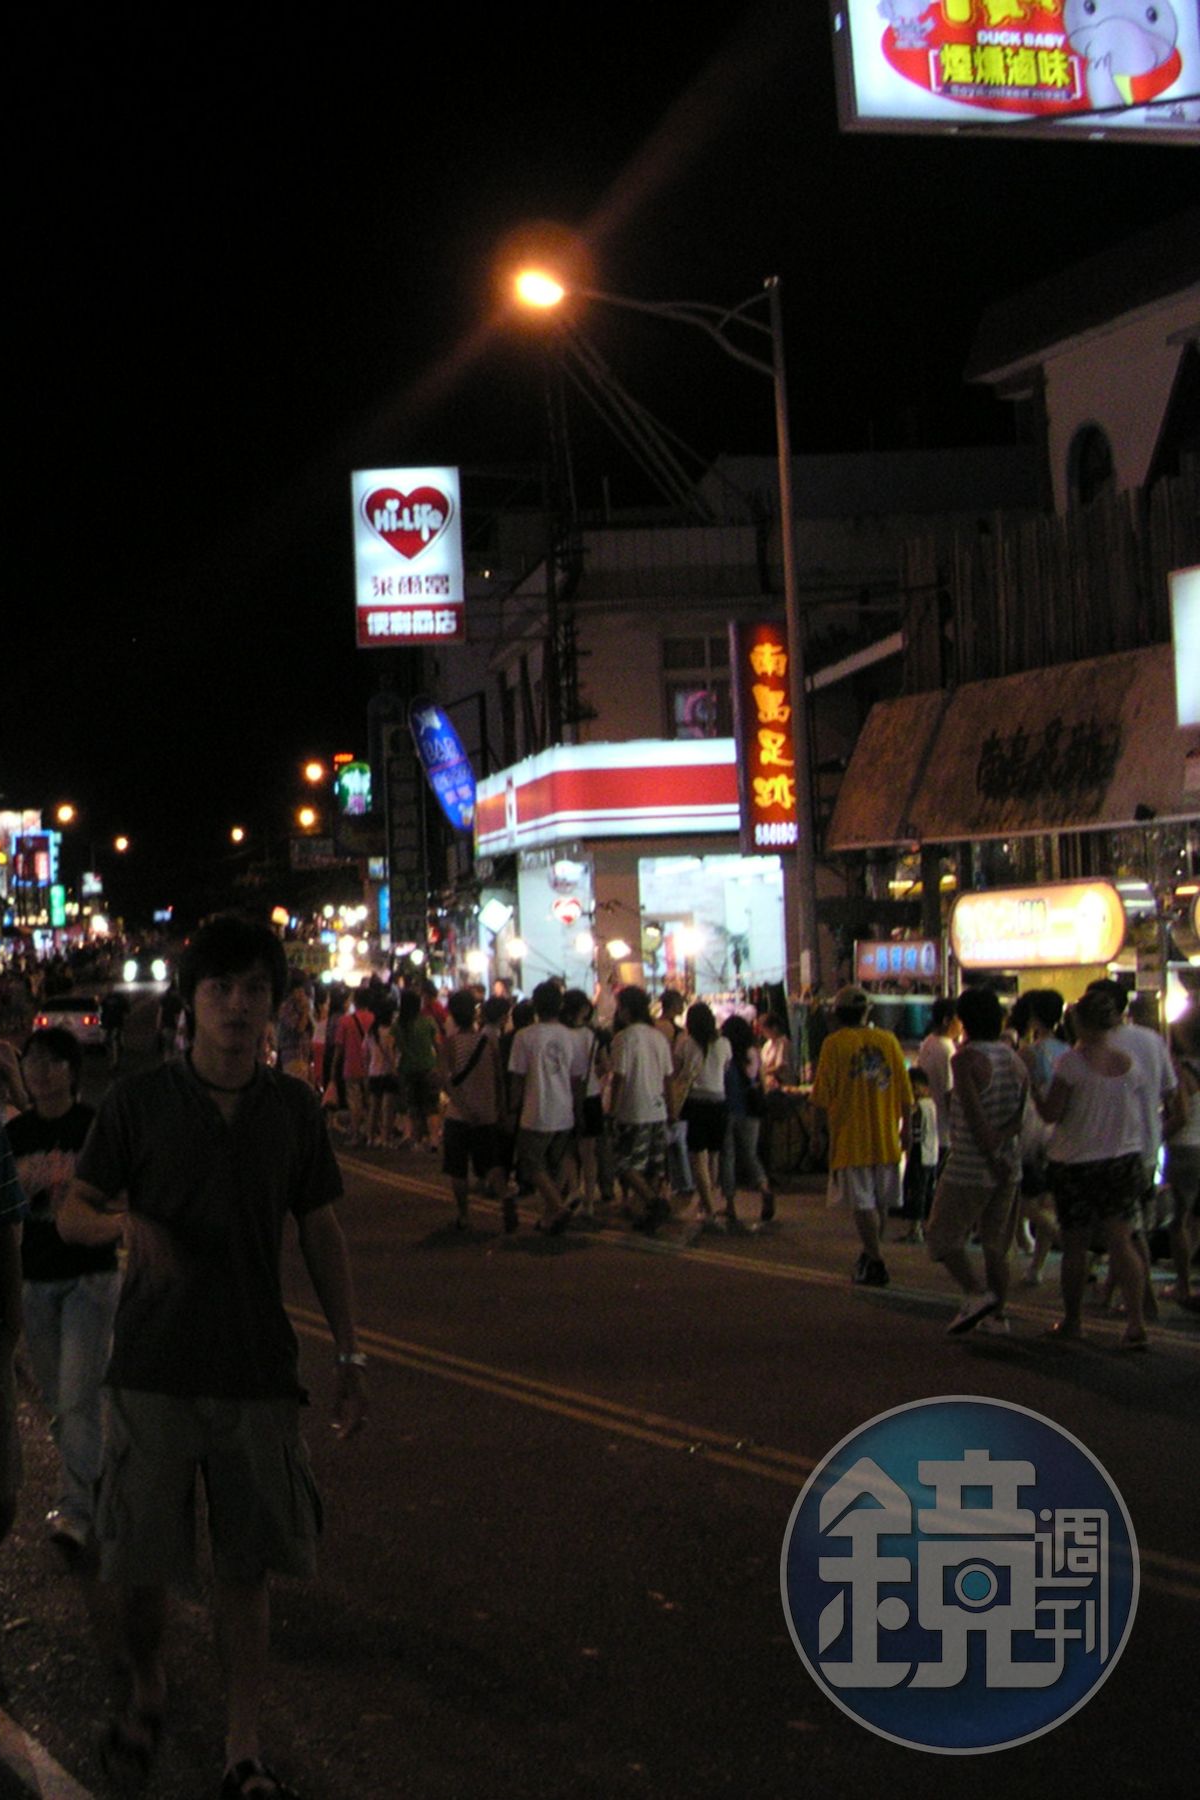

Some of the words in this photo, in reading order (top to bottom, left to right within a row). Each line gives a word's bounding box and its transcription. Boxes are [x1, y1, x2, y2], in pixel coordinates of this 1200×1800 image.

[977, 30, 1021, 45] DUCK
[1024, 32, 1066, 48] BABY
[373, 499, 444, 542] Hi-Life
[372, 574, 450, 596] 萊爾富
[367, 609, 457, 636] 便利商店
